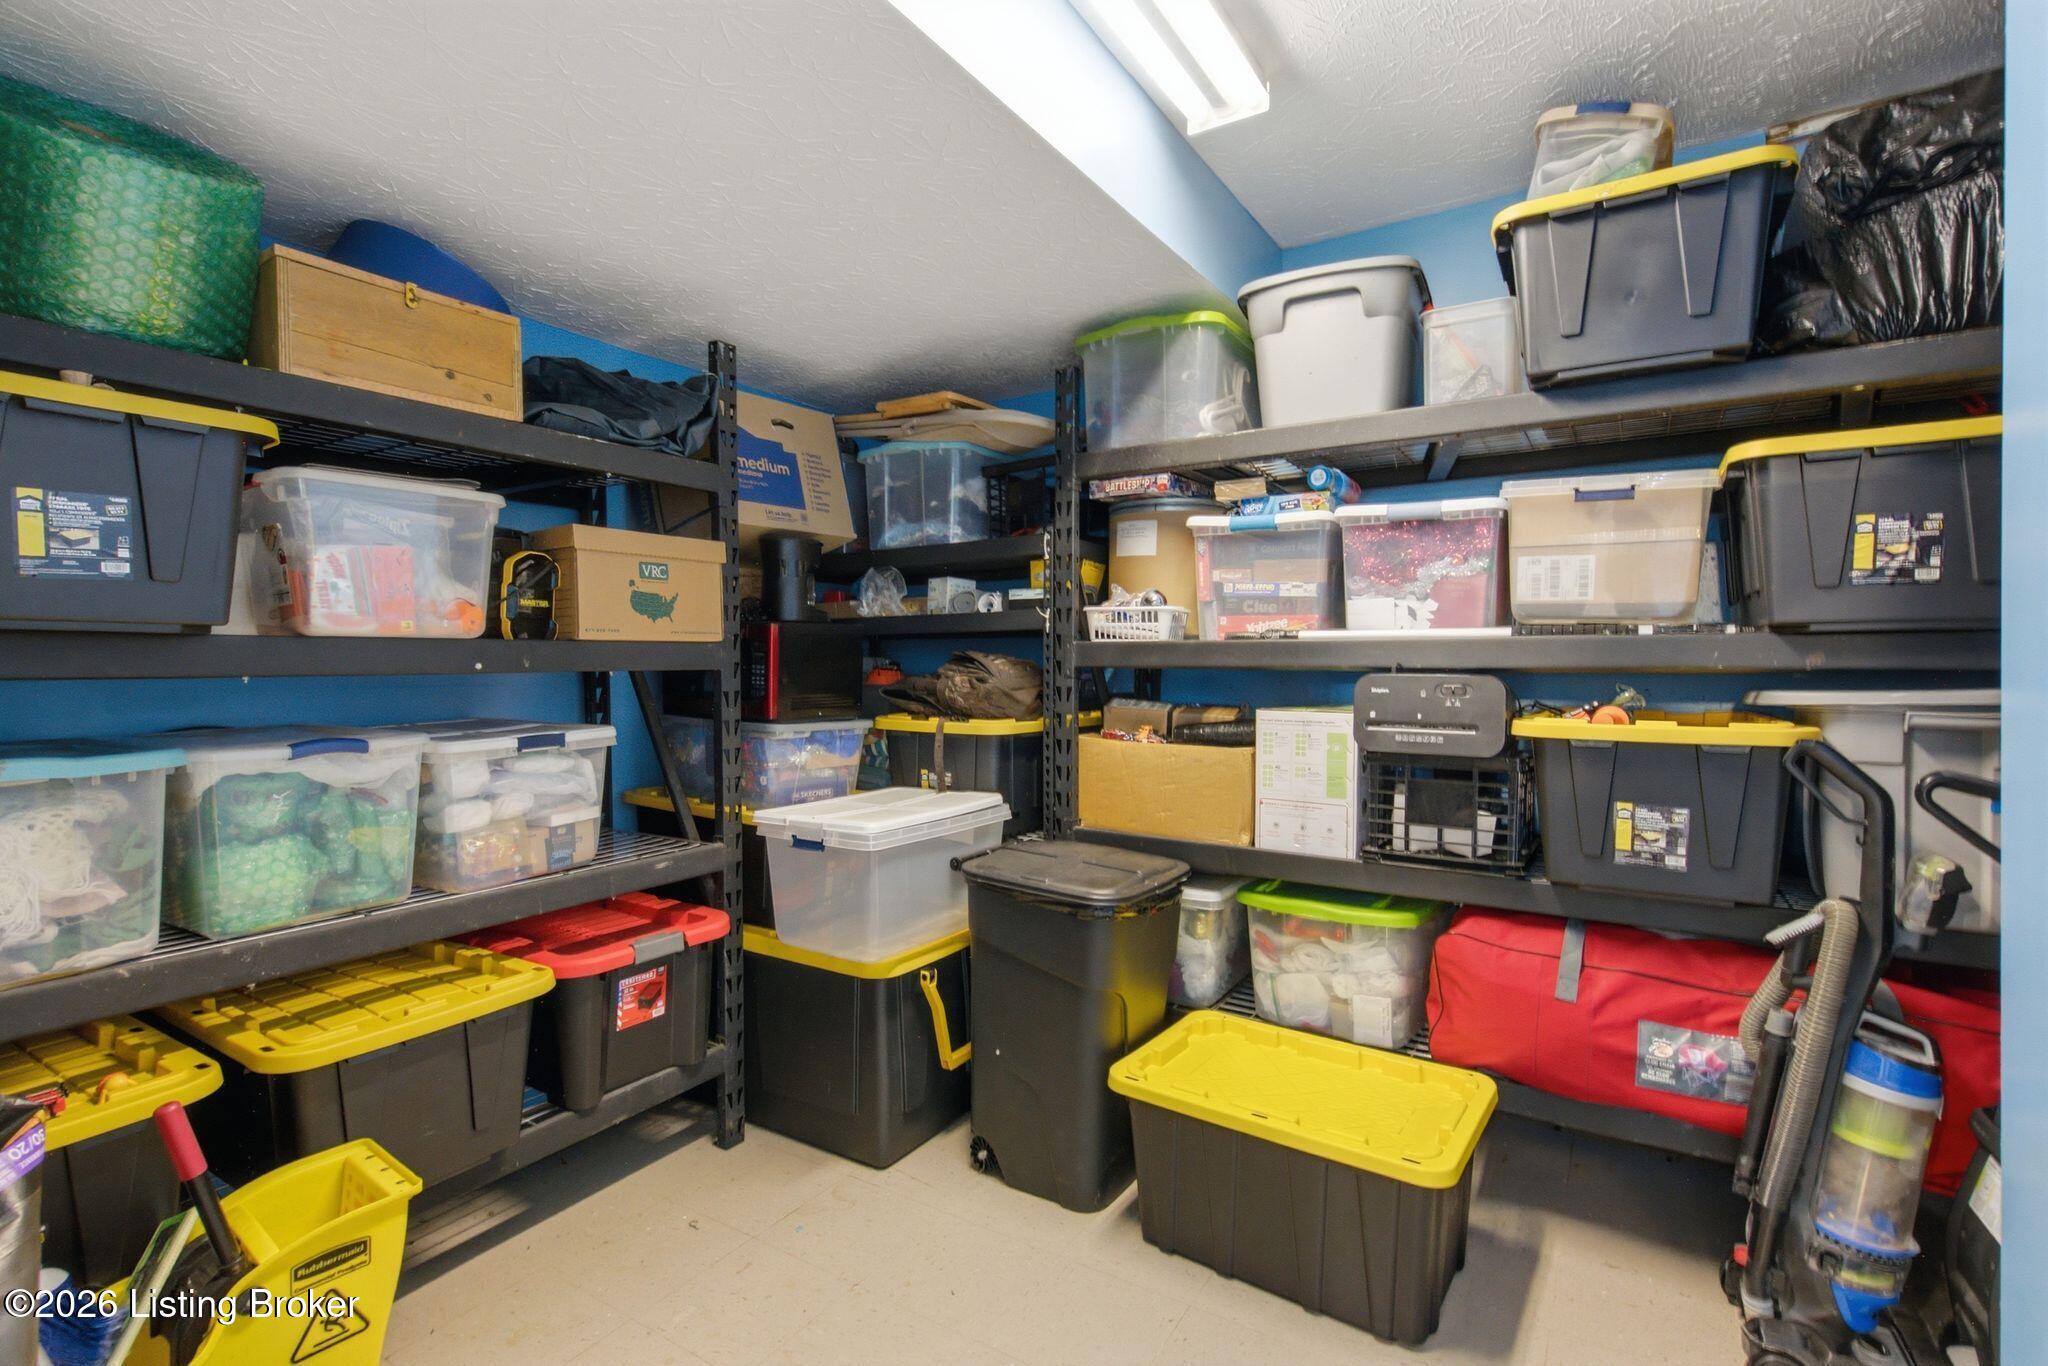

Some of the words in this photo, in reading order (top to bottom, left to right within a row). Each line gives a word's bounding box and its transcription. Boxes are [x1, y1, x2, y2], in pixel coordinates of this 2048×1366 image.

[737, 456, 790, 476] medium
[641, 564, 668, 579] VRC
[1243, 599, 1278, 613] Clue
[297, 1243, 365, 1279] Rubbermaid
